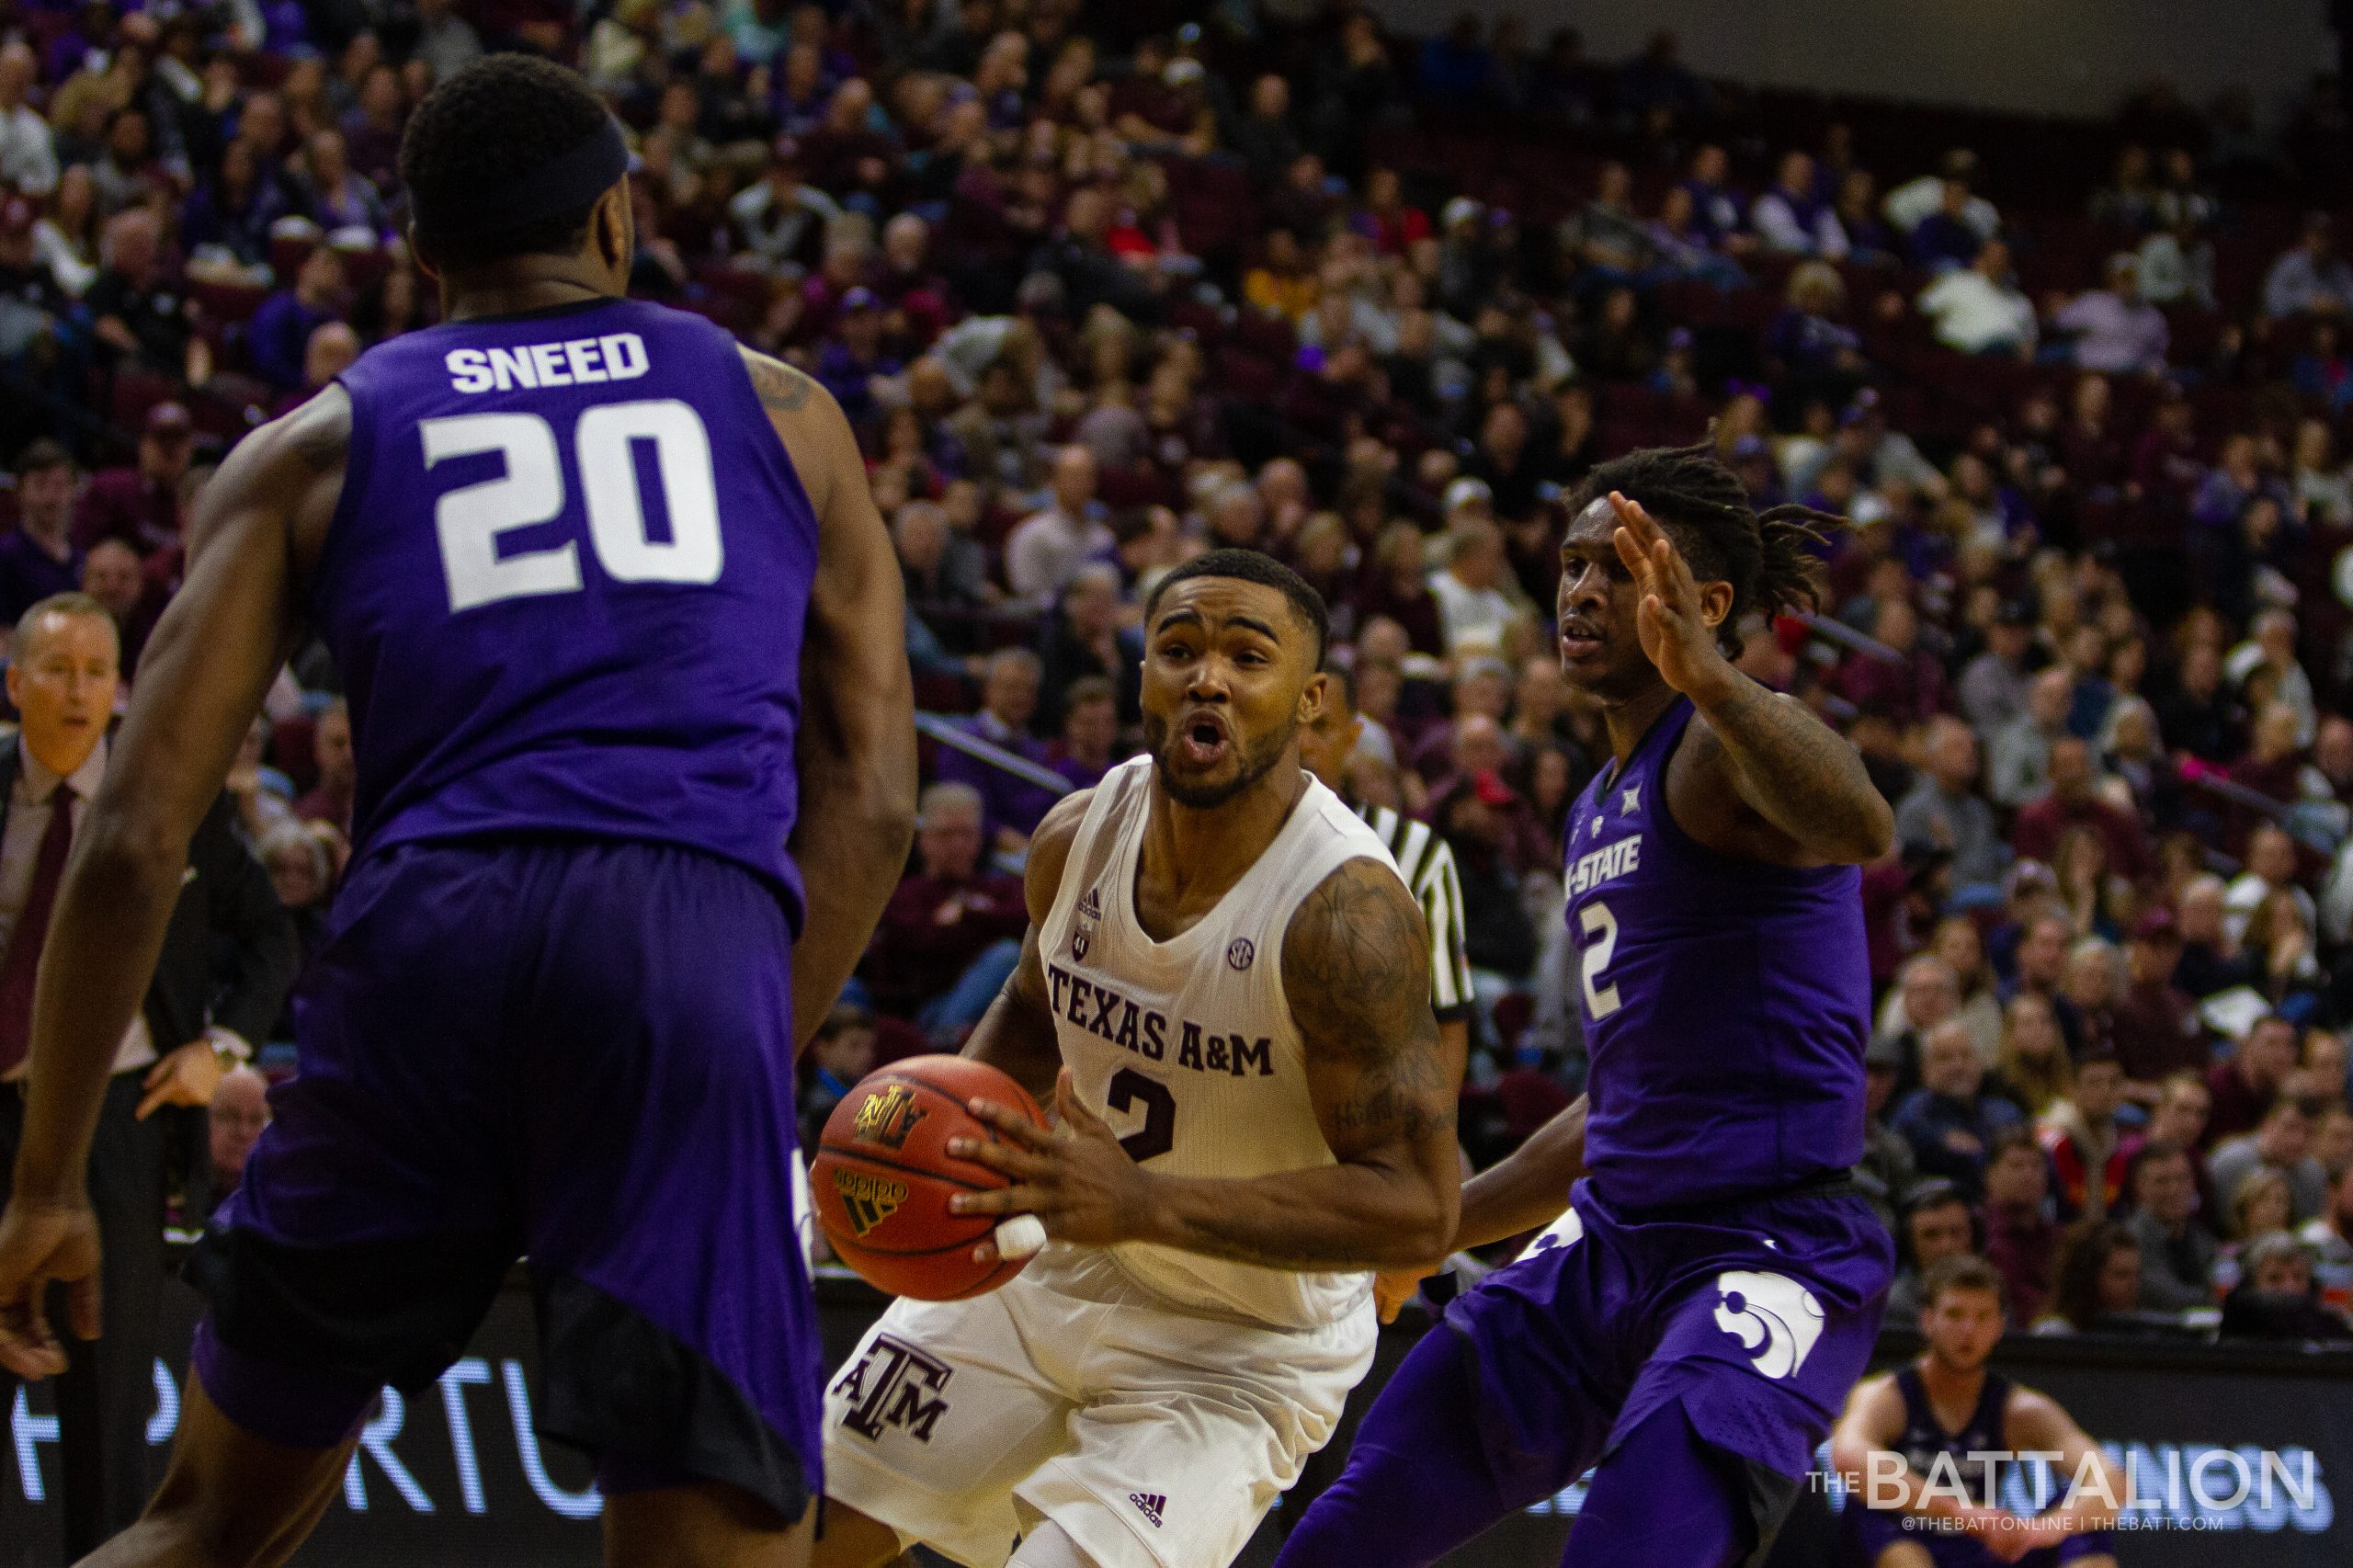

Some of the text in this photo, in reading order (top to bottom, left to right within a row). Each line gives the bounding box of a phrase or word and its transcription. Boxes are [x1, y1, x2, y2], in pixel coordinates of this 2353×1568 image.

[445, 333, 650, 393] SNEED
[418, 398, 724, 614] 20
[1579, 901, 1621, 1022] 2
[1048, 963, 1274, 1077] TEXAS A&M
[1107, 1066, 1176, 1164] 2
[1129, 1493, 1163, 1528] adidas
